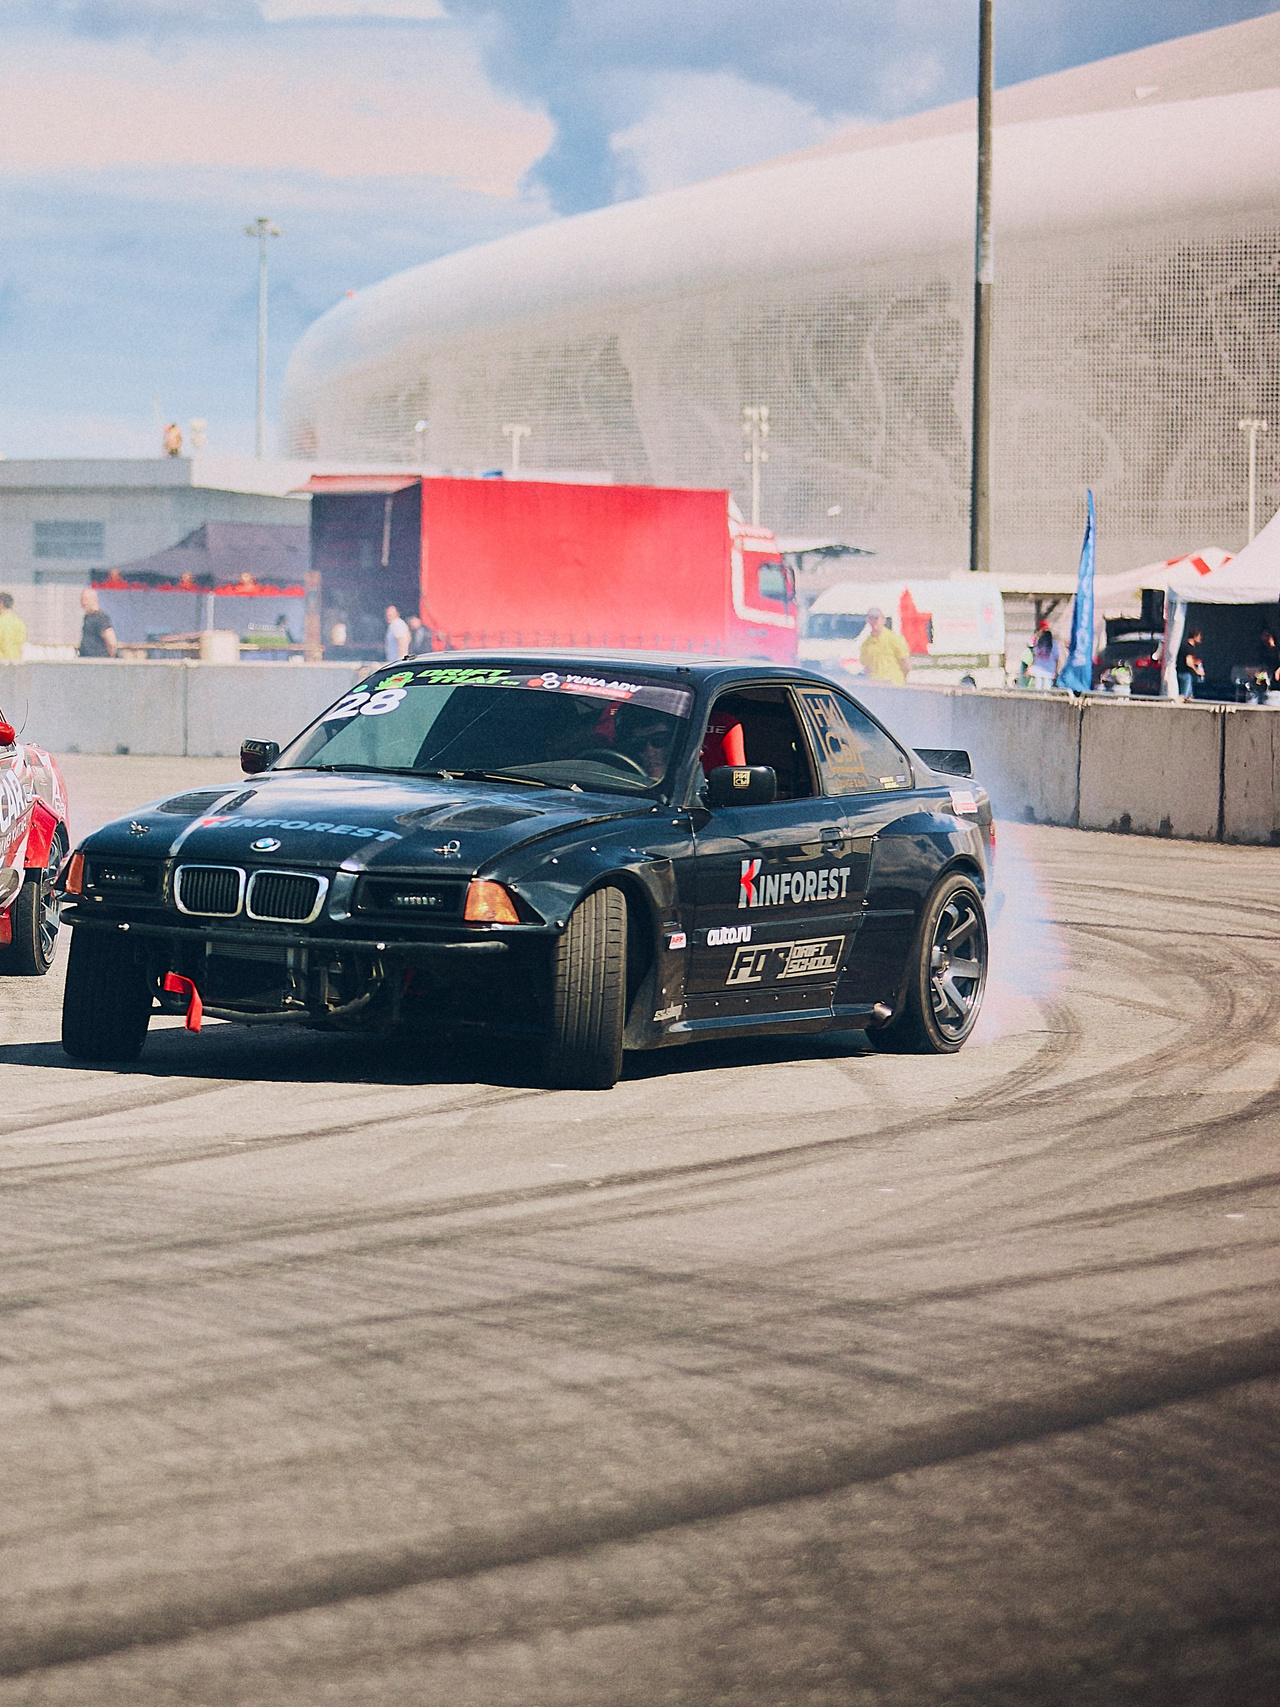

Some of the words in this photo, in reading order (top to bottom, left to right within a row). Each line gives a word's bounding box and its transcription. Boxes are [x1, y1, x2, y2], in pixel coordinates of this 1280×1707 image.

[416, 668, 512, 677] DRIFT
[566, 674, 606, 687] YUKA
[606, 681, 643, 693] ADV
[566, 683, 586, 692] PRO
[588, 686, 628, 698] RACING
[323, 688, 407, 721] 28
[738, 859, 851, 908] KINFOREST
[791, 943, 828, 959] DRIFT
[786, 955, 835, 973] SCHOOL
